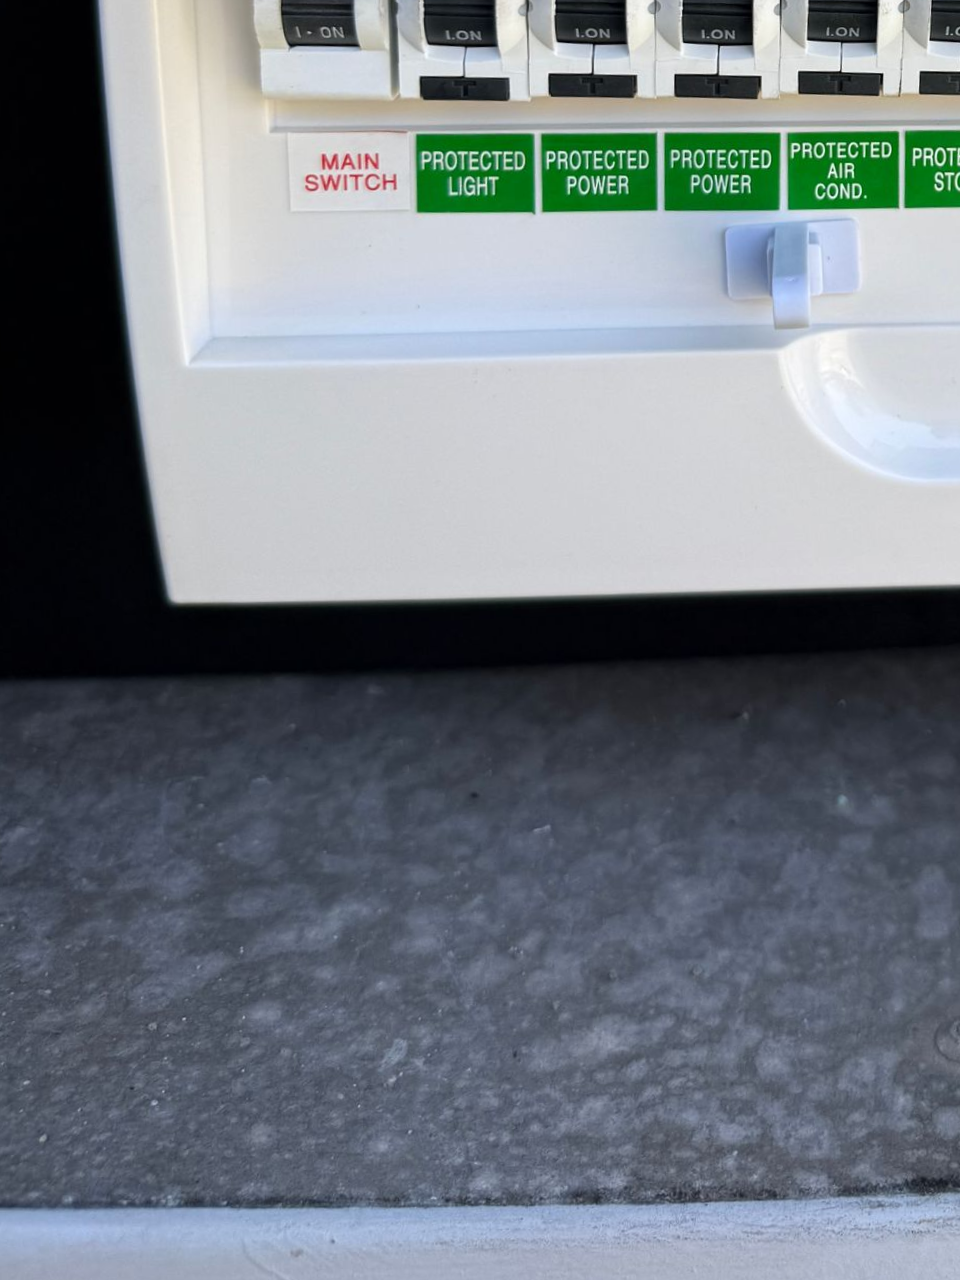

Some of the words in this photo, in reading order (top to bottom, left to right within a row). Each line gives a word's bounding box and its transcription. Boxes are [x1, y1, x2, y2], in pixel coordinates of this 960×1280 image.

[322, 26, 345, 40] ON
[545, 149, 650, 171] PROTECTED
[669, 149, 772, 170] PROTECTED
[790, 141, 893, 160] PROTECTED
[320, 152, 380, 171] MAIN
[420, 150, 526, 172] PROTECTED
[827, 162, 856, 180] AIR
[303, 173, 398, 192] SWITCH
[447, 175, 499, 197] LIGHT
[565, 174, 630, 196] POWER
[690, 174, 752, 195] POWER
[813, 182, 868, 200] COND.
